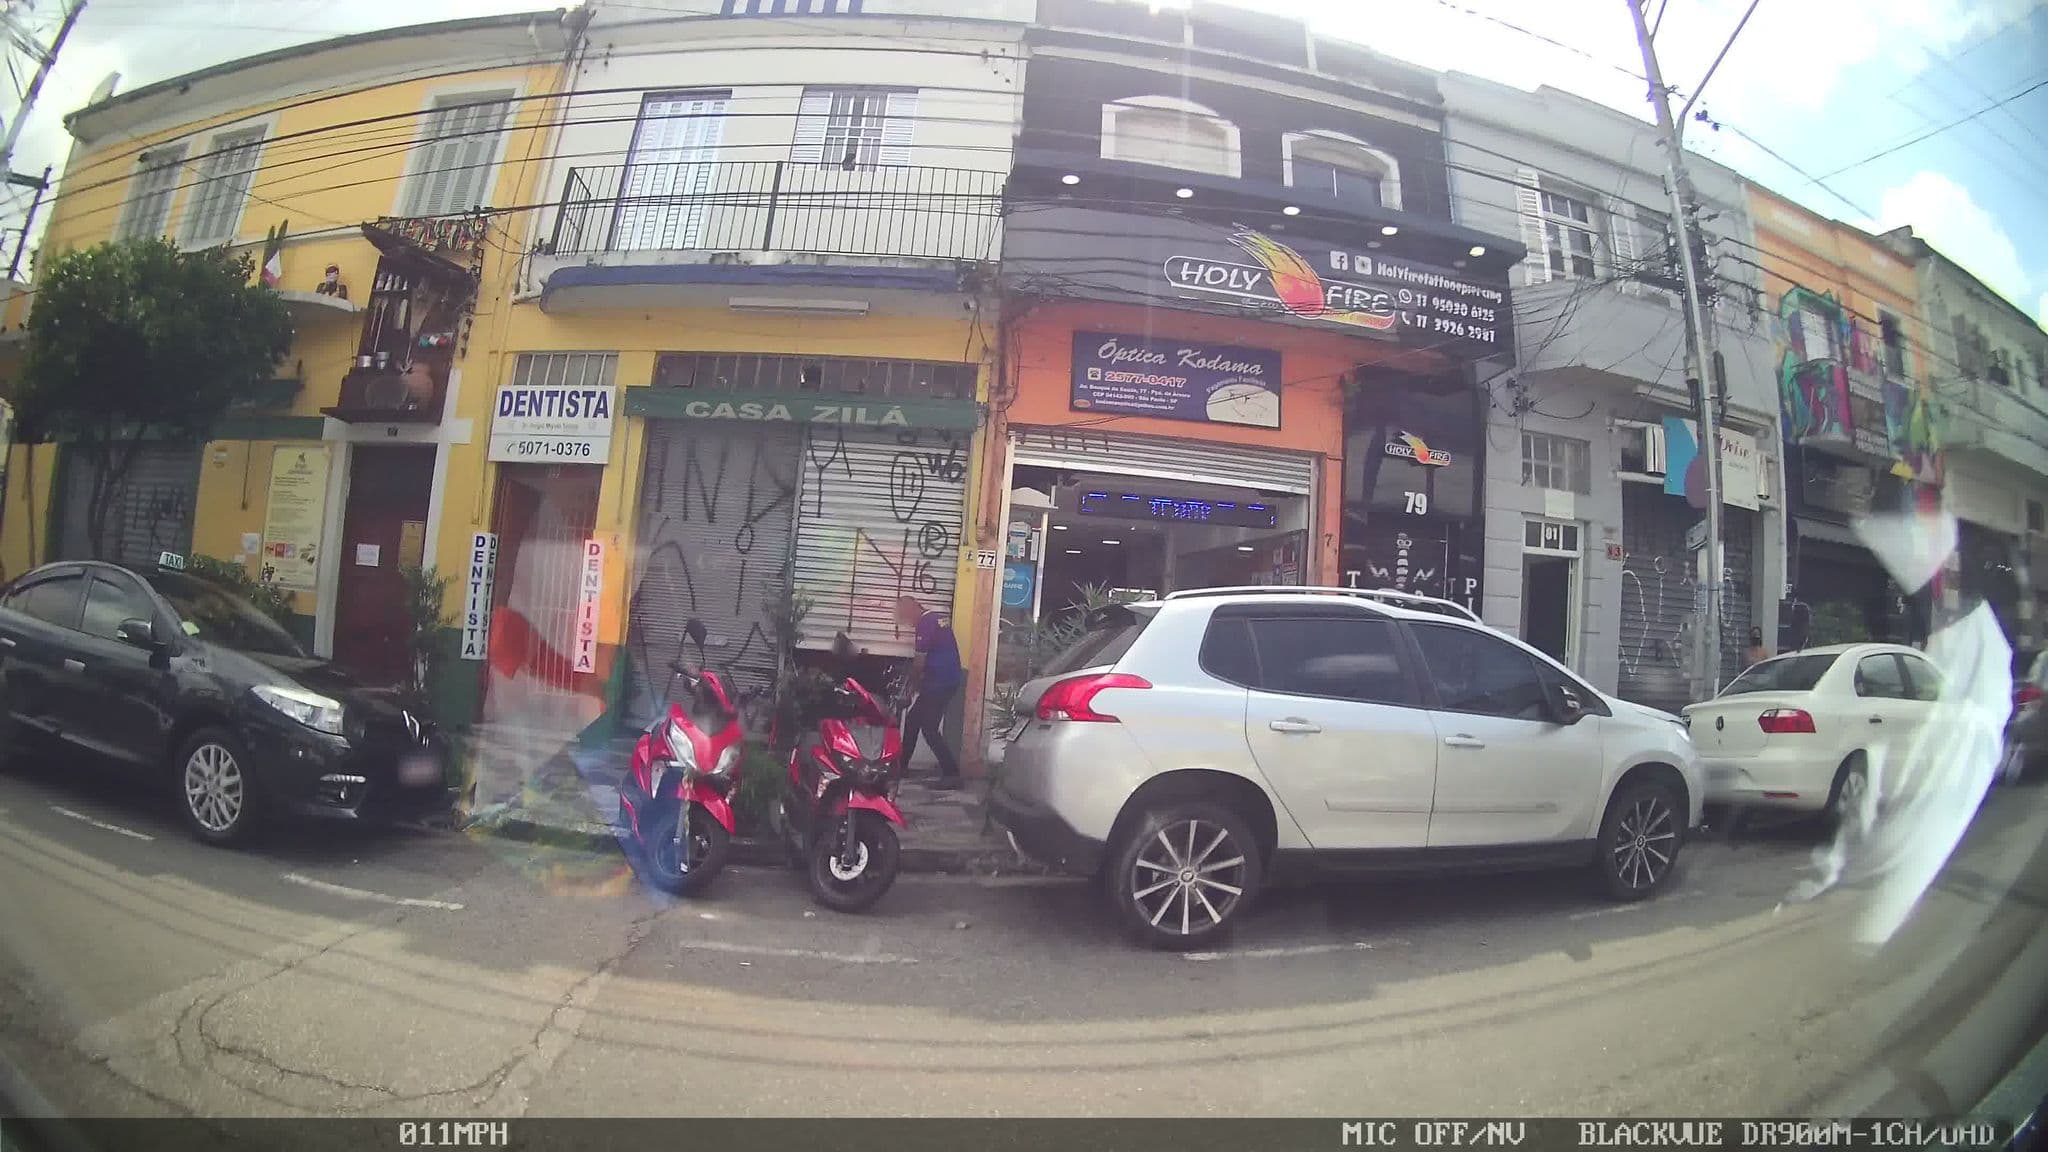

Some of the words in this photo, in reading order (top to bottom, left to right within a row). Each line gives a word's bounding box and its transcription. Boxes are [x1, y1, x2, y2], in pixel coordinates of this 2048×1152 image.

[1180, 261, 1262, 291] HOLY
[1326, 286, 1389, 313] FIRE
[1434, 317, 1464, 336] 3926
[1098, 338, 1167, 366] Óptica
[1177, 348, 1264, 376] Kodama
[1104, 371, 1187, 388] 2577-0417
[499, 390, 609, 419] DENTISTA
[685, 401, 792, 421] CASA
[810, 405, 909, 427] ZILÁ
[518, 441, 590, 457] 5071-0376
[1388, 445, 1412, 457] HOLY
[1429, 451, 1449, 461] FIRE
[1404, 491, 1427, 515] 79
[978, 553, 995, 565] 77
[464, 535, 486, 656] DENTISTA
[479, 536, 497, 656] DENTISTA
[578, 543, 600, 668] DENTISTA
